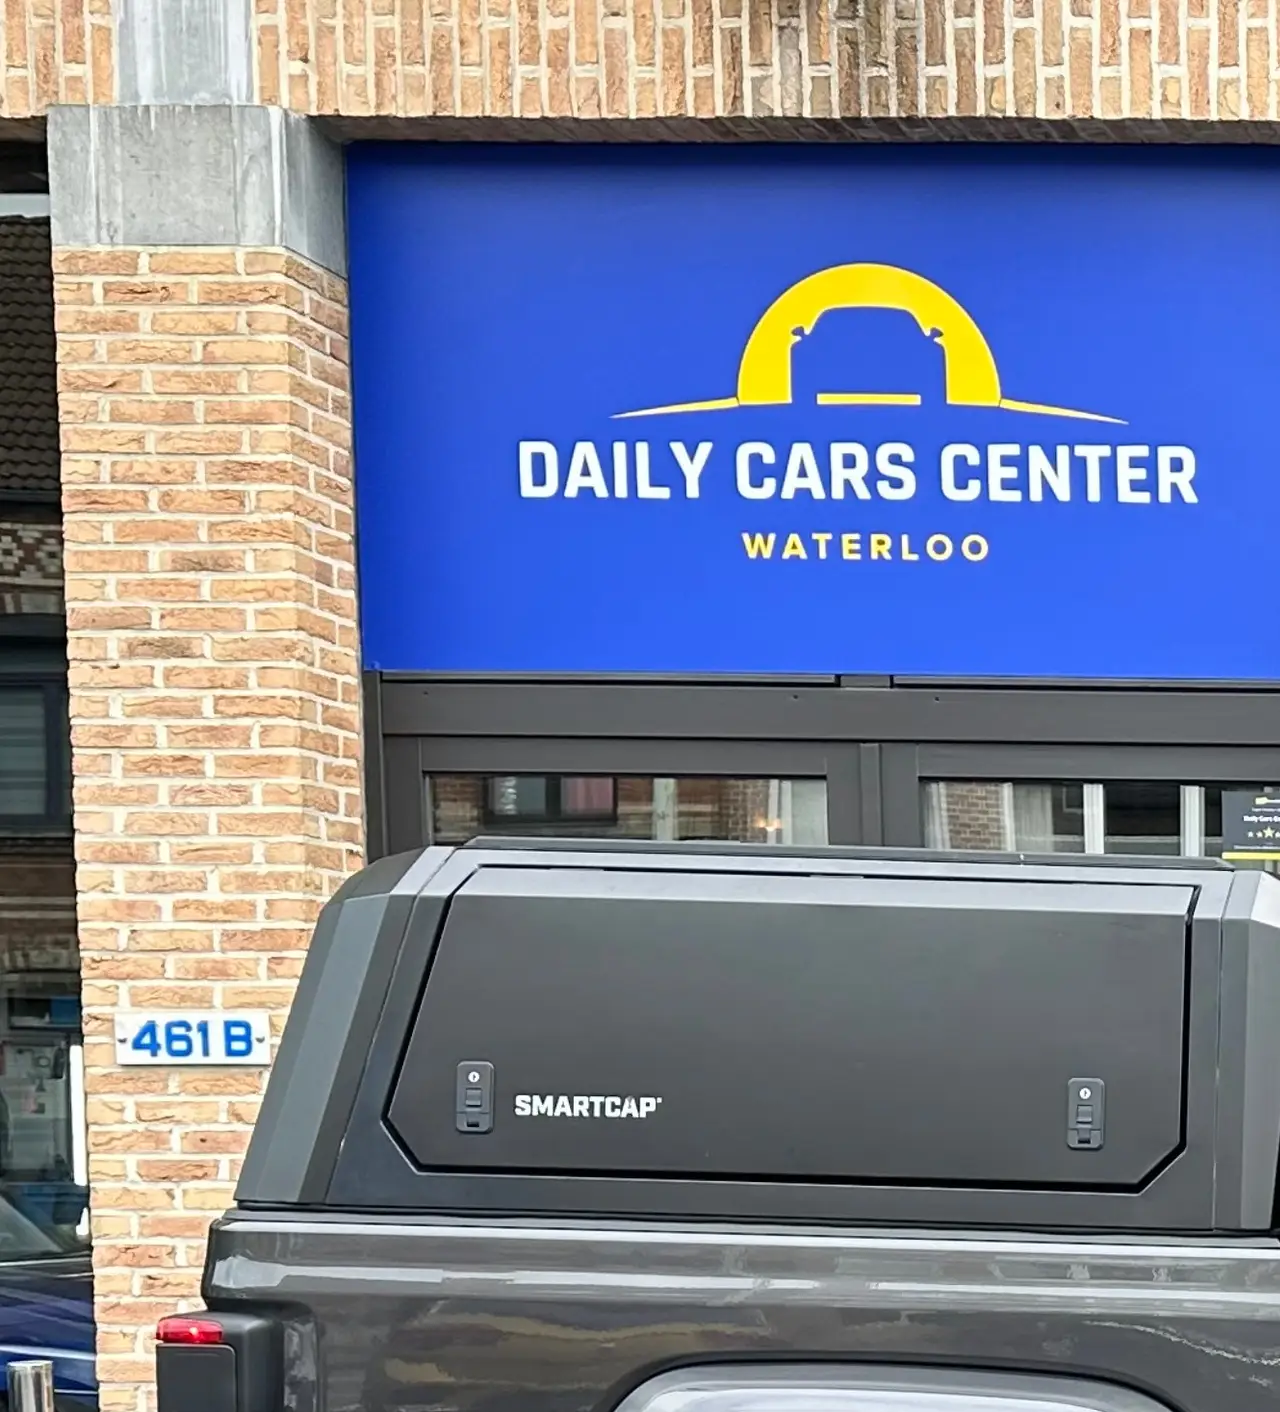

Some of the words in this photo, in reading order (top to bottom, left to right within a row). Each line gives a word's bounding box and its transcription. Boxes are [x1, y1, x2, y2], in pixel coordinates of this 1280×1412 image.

[518, 440, 714, 499] DAILY
[734, 441, 917, 501] CARS
[940, 443, 1199, 504] CENTER
[741, 532, 989, 561] WATERLOO
[131, 1020, 210, 1058] 461
[223, 1020, 253, 1058] B
[514, 1094, 658, 1119] SMARTCAP
